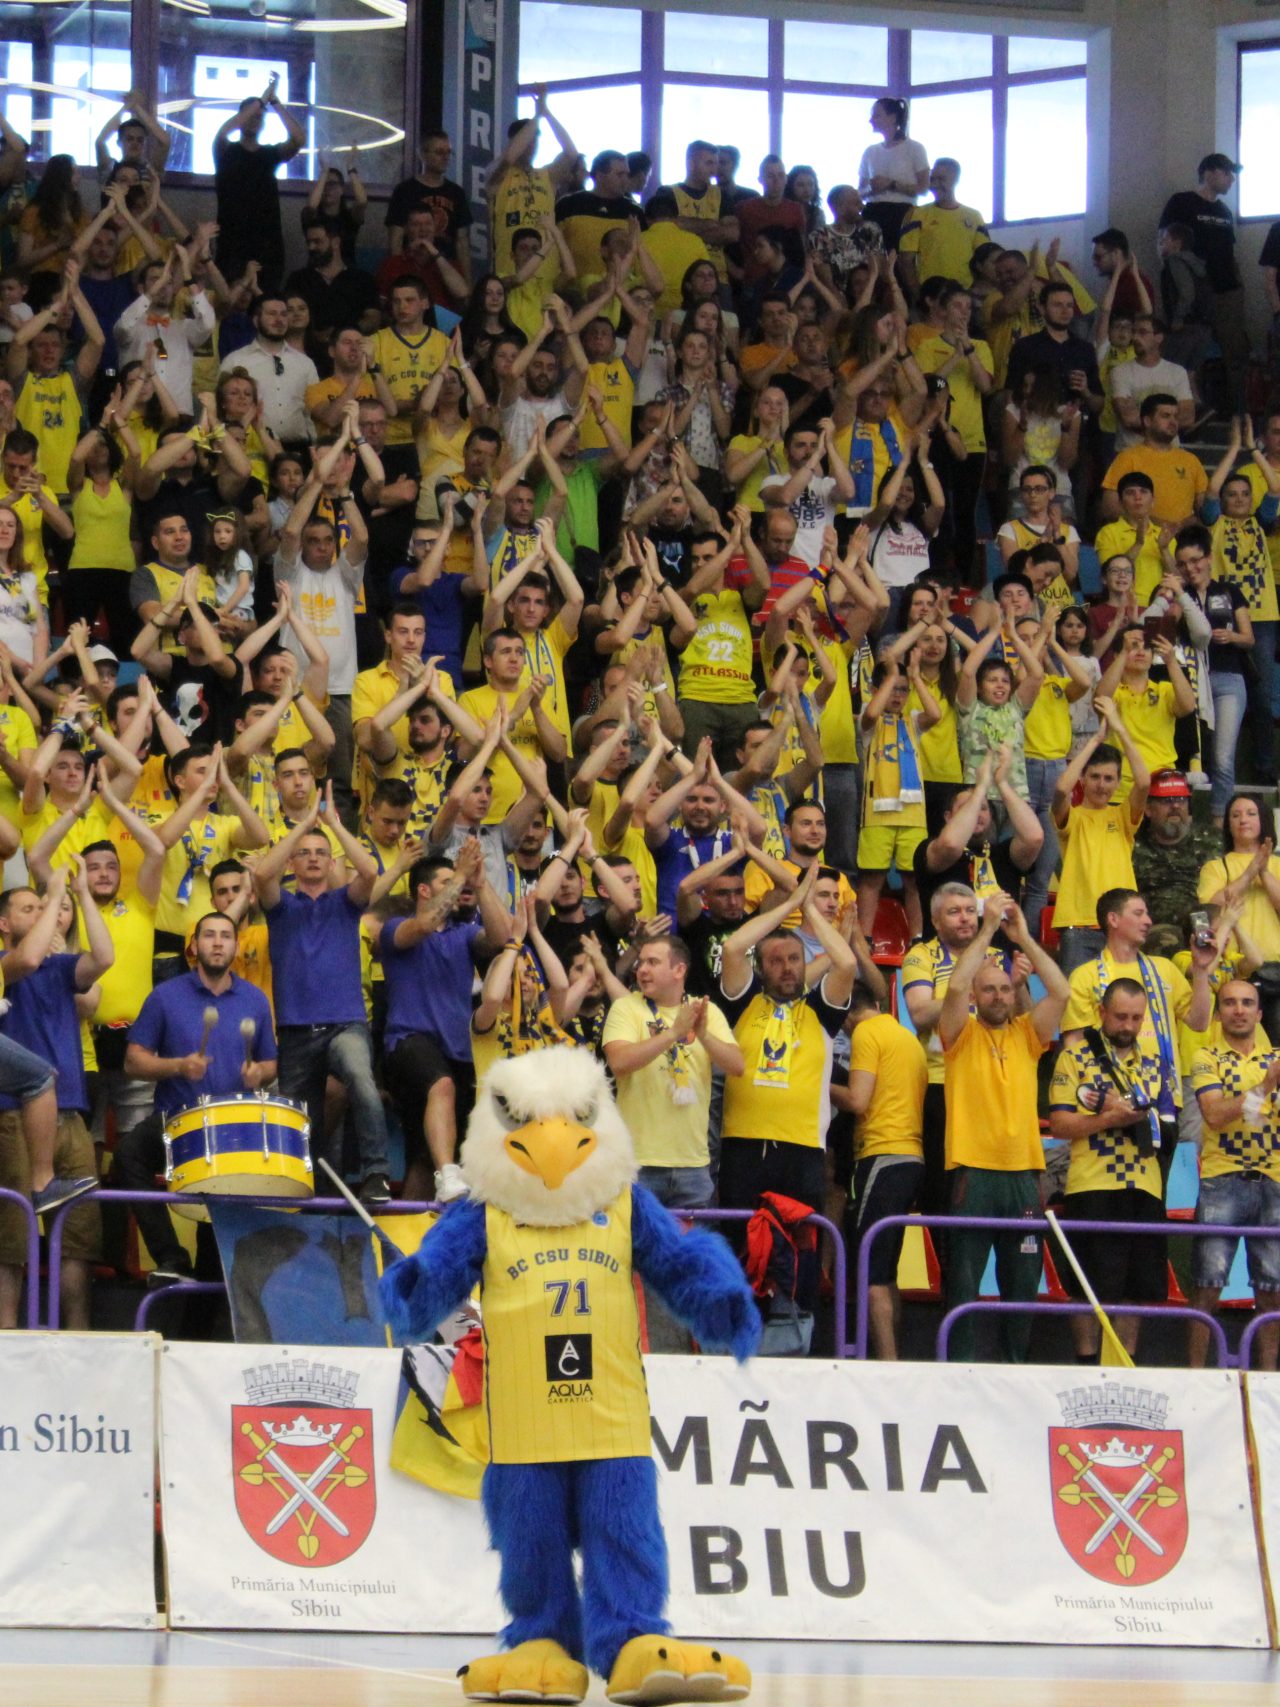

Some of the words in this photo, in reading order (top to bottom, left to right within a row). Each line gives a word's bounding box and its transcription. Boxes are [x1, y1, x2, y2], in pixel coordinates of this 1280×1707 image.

[707, 640, 733, 662] 22
[506, 1258, 529, 1281] BC
[534, 1247, 570, 1266] CSU
[577, 1247, 620, 1274] SIBIU
[543, 1277, 592, 1318] 71
[547, 1382, 593, 1399] AQUA
[34, 1412, 132, 1455] Sibiu
[299, 1578, 396, 1597] Municipiului
[291, 1599, 341, 1617] Sibiu
[1119, 1596, 1213, 1614] Municipiului
[1114, 1615, 1163, 1633] Sibiu
